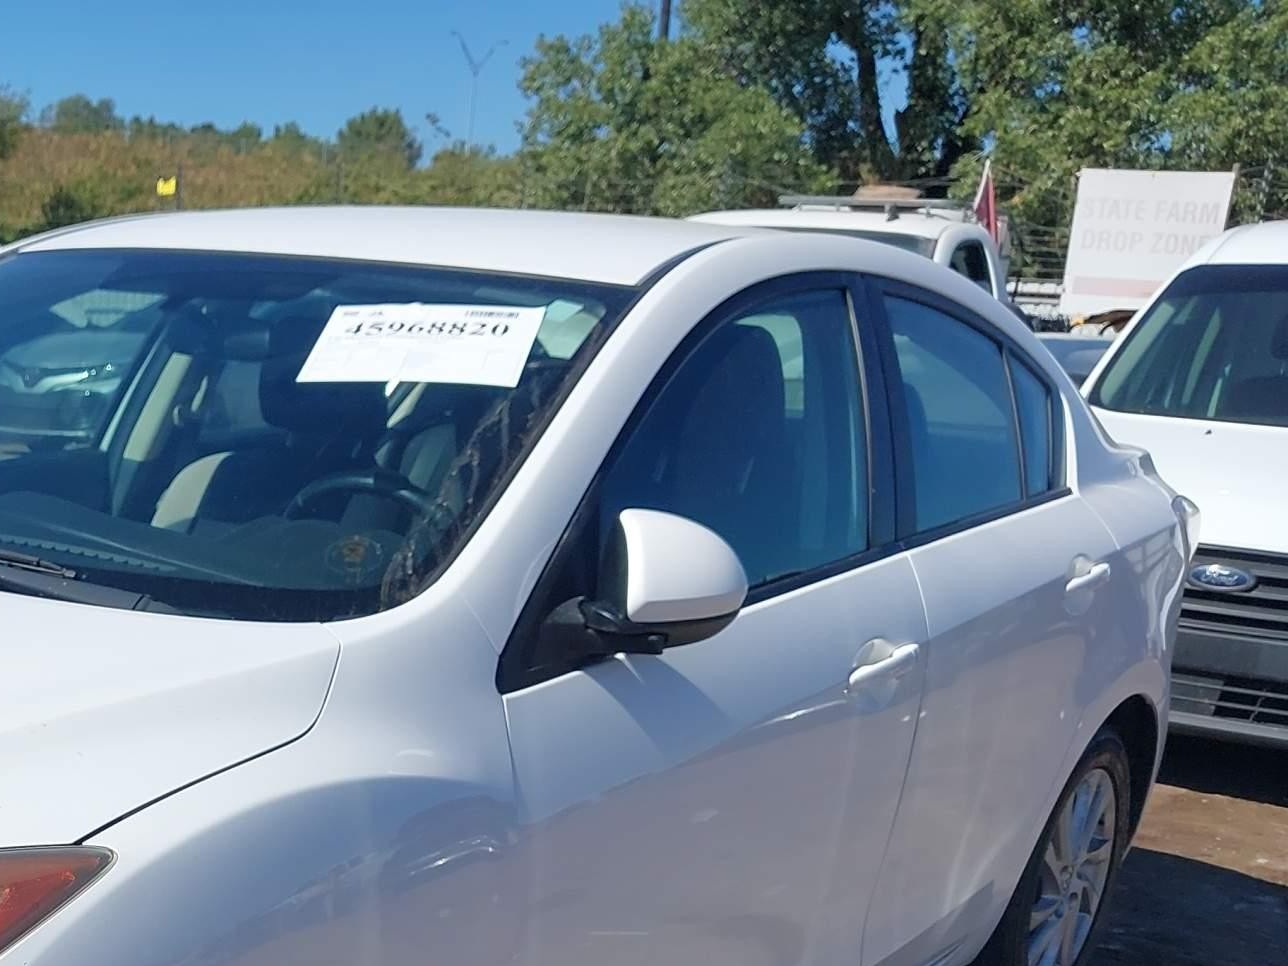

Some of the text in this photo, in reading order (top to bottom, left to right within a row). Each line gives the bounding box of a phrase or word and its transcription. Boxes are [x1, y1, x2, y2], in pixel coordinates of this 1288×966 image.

[1081, 198, 1221, 224] STATE FARM
[1081, 229, 1144, 253] DROP
[345, 321, 511, 337] 45968820
